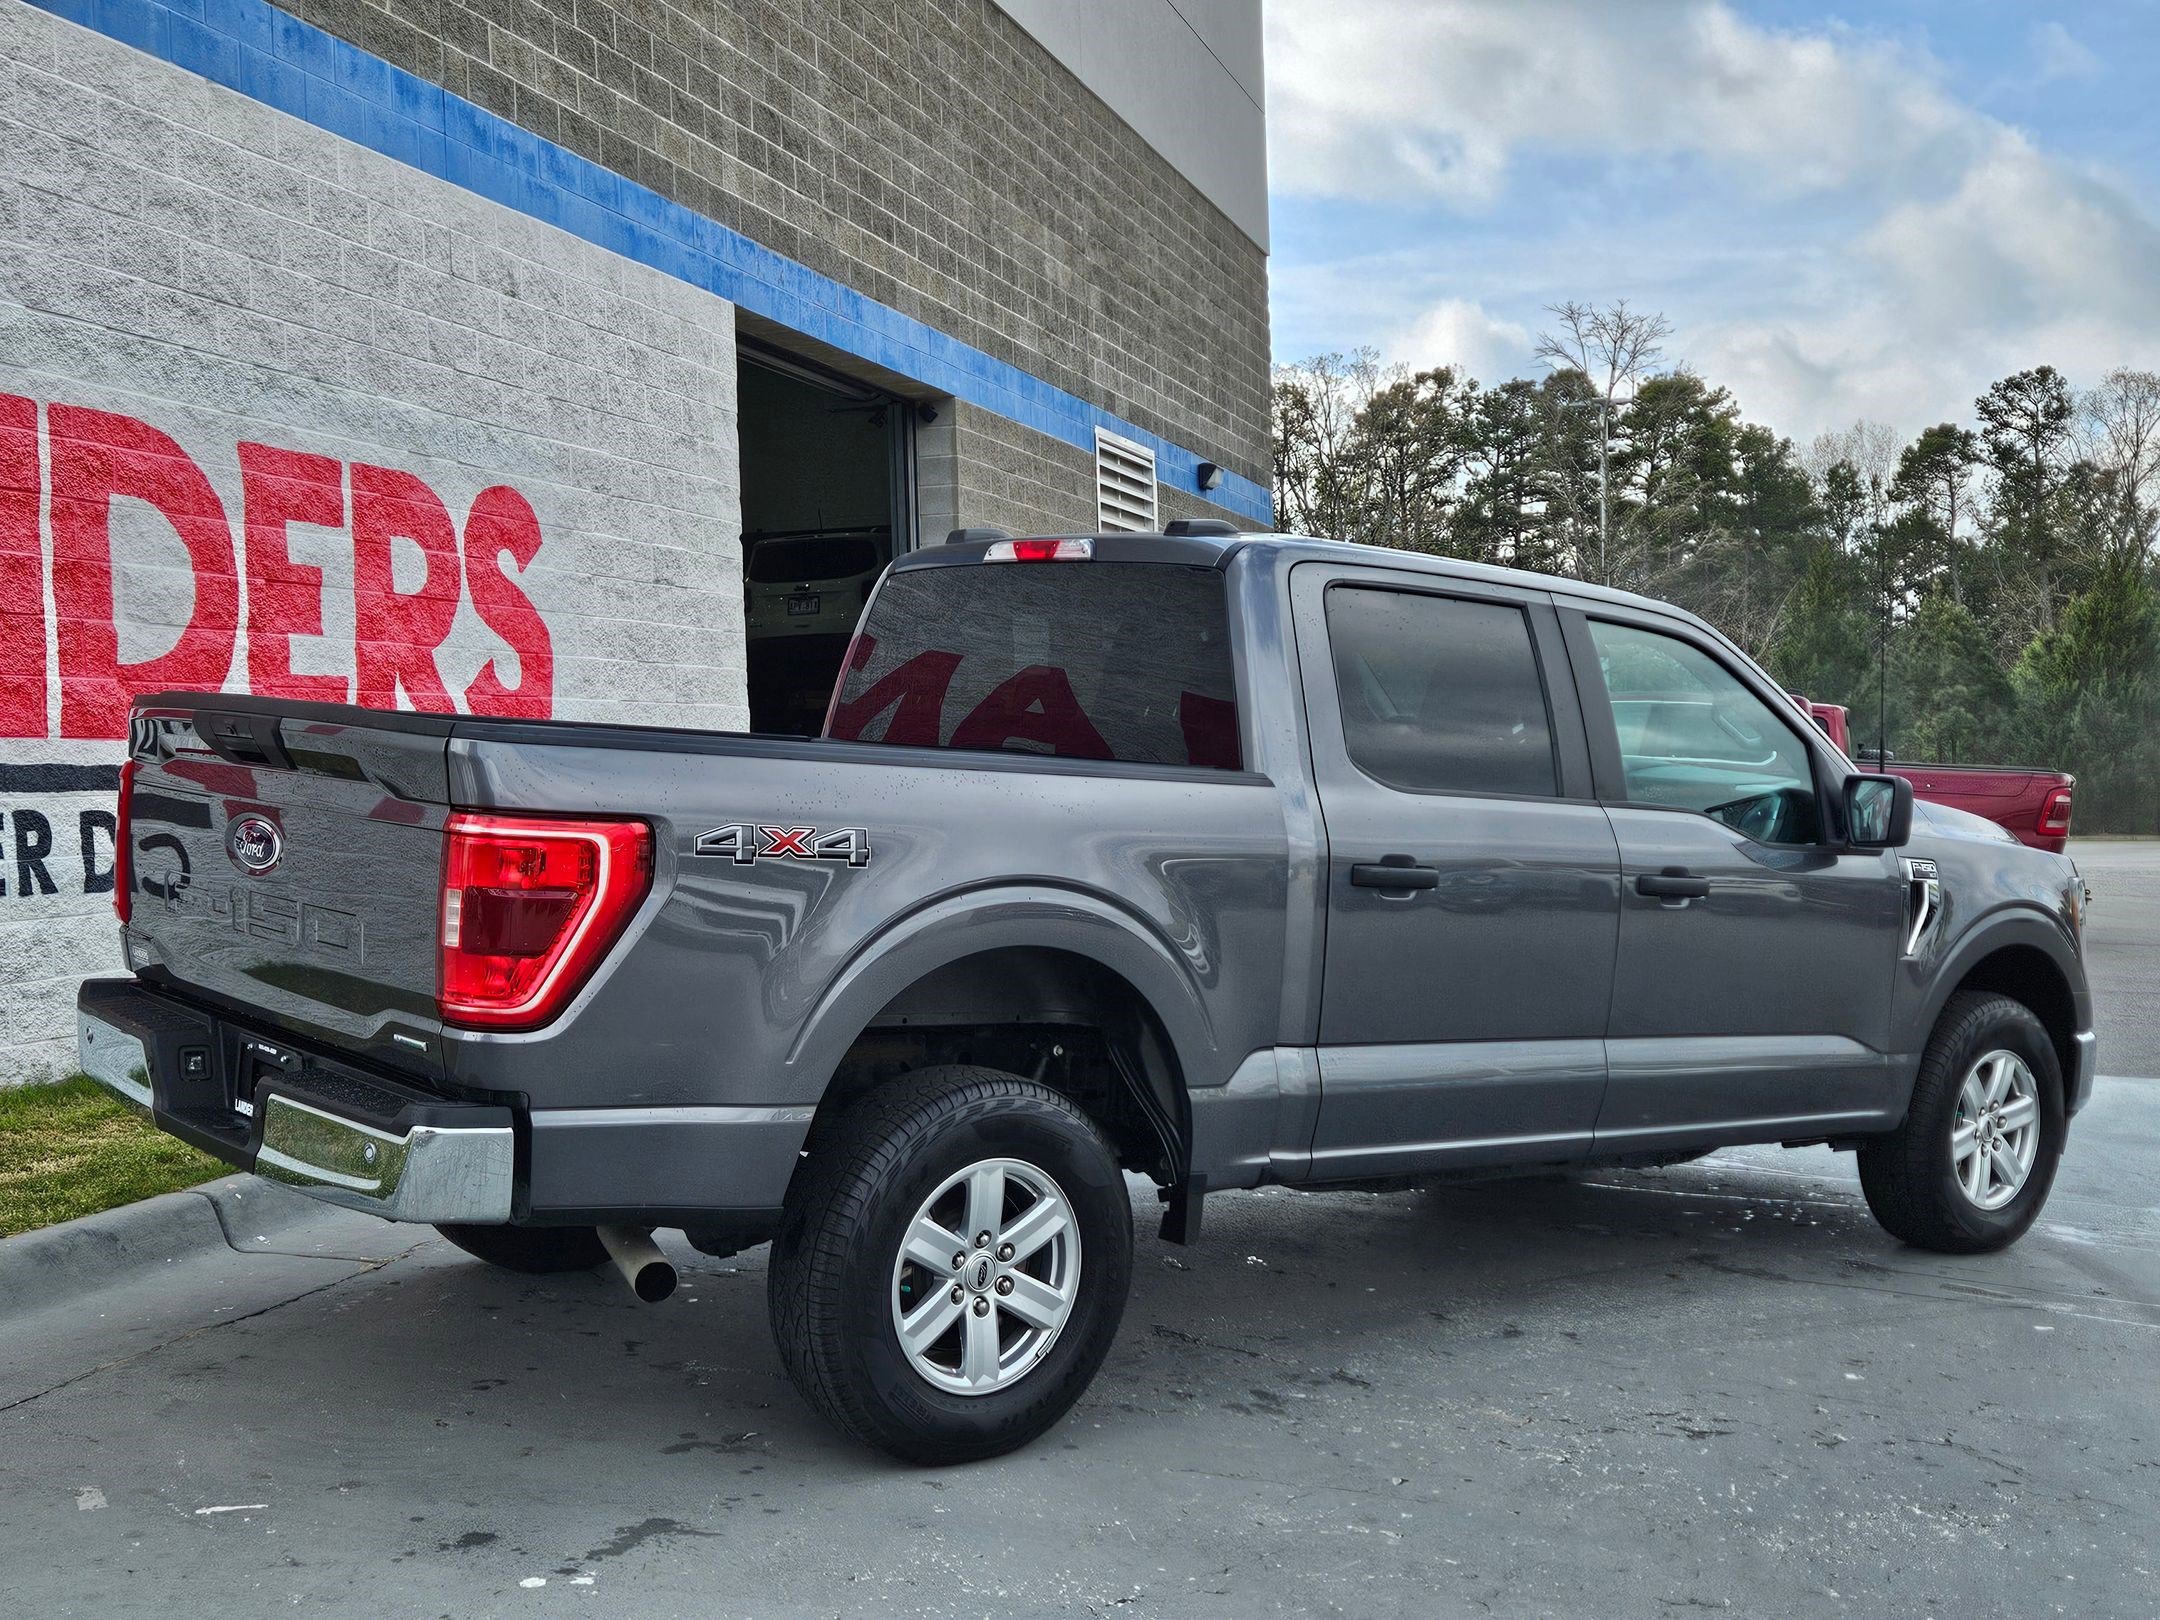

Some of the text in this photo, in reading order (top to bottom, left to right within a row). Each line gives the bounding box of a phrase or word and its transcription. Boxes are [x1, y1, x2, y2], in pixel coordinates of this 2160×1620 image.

[0, 391, 553, 740] DERS
[0, 809, 59, 896] R
[240, 831, 266, 858] Ford
